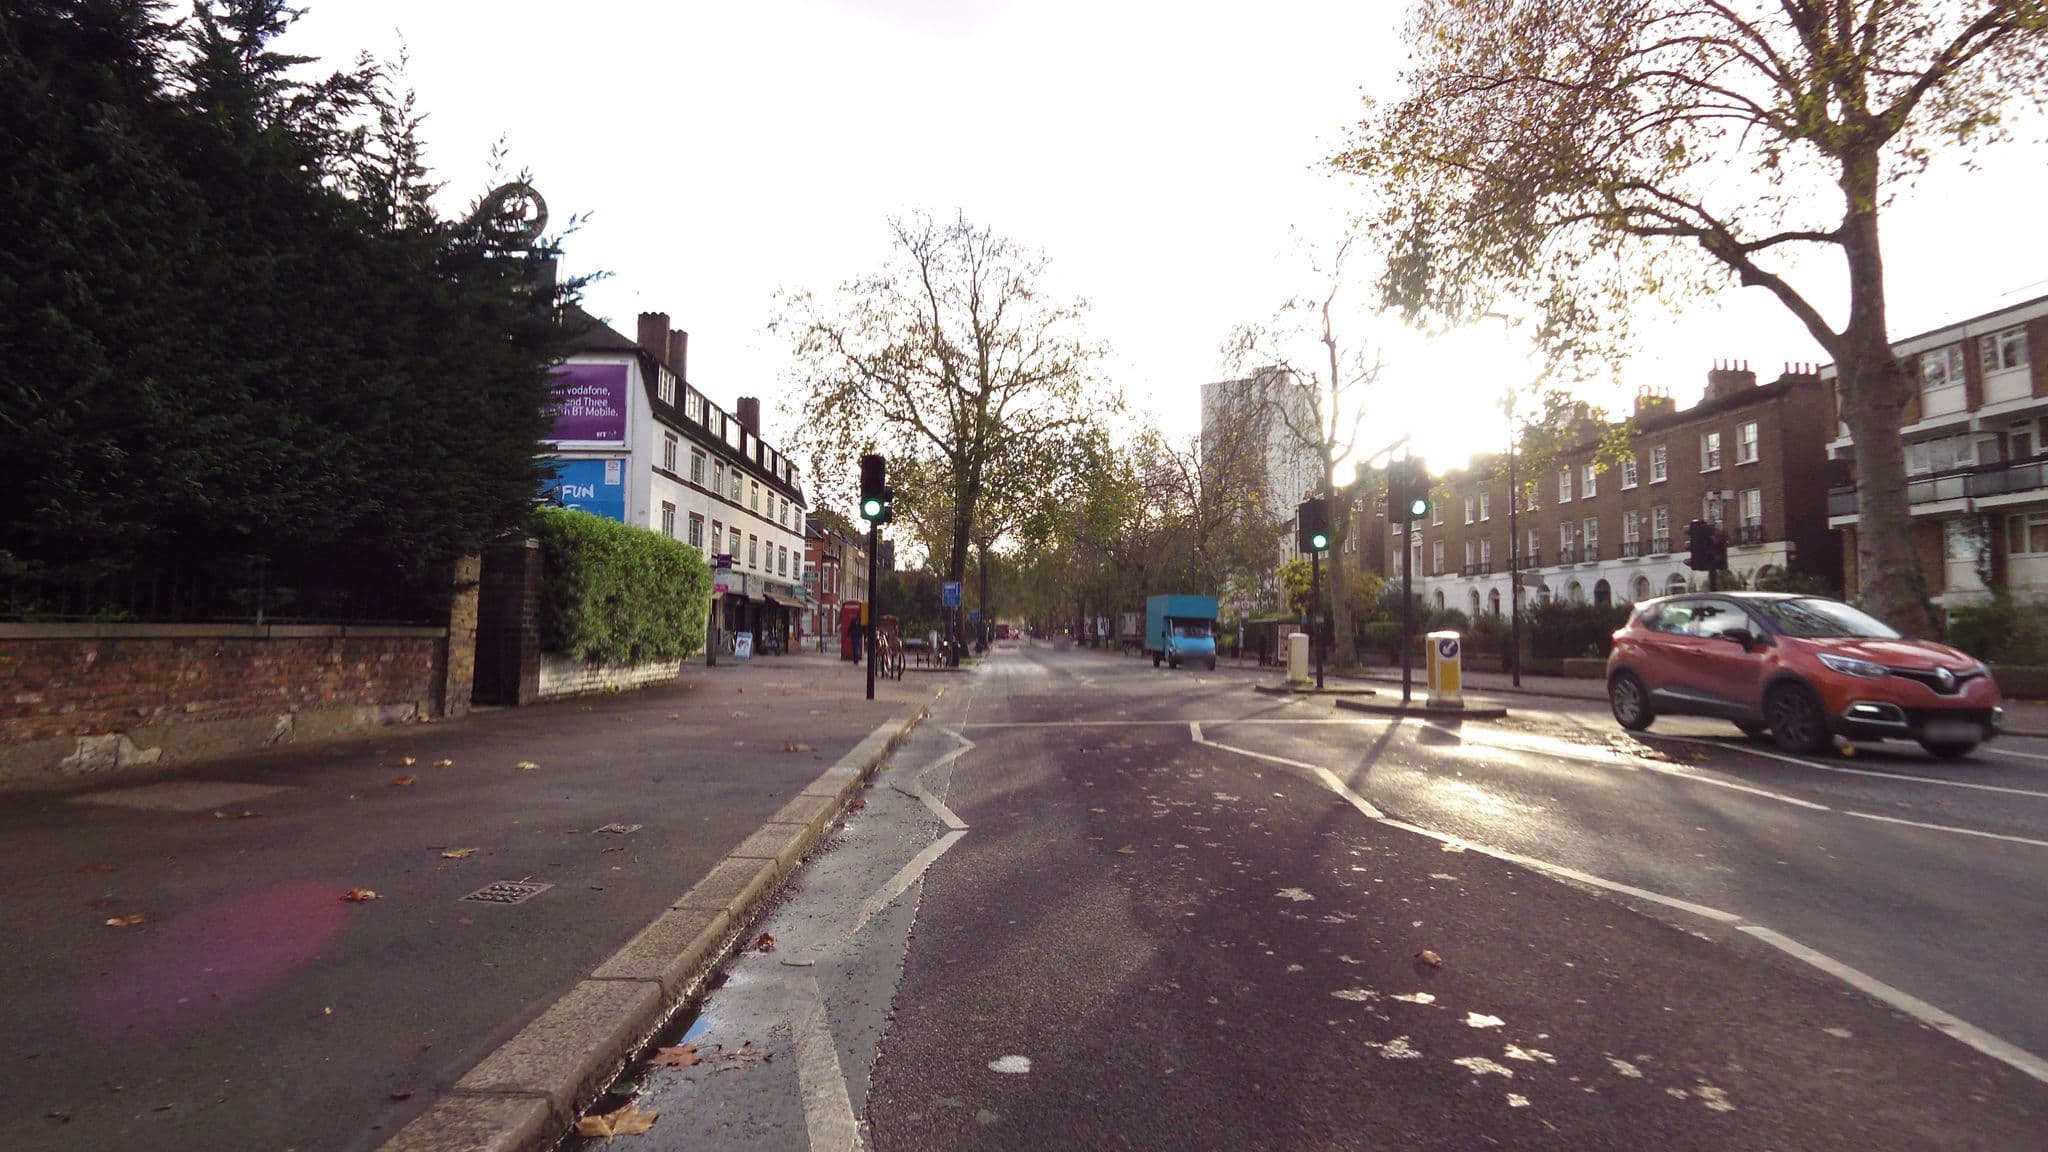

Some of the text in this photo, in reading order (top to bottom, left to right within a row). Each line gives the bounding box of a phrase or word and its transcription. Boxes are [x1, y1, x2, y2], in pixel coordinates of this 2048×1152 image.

[567, 385, 610, 396] vodafone,
[583, 397, 608, 407] Three
[572, 407, 583, 416] BT
[585, 407, 618, 416] Mobile.
[562, 484, 594, 500] FUN
